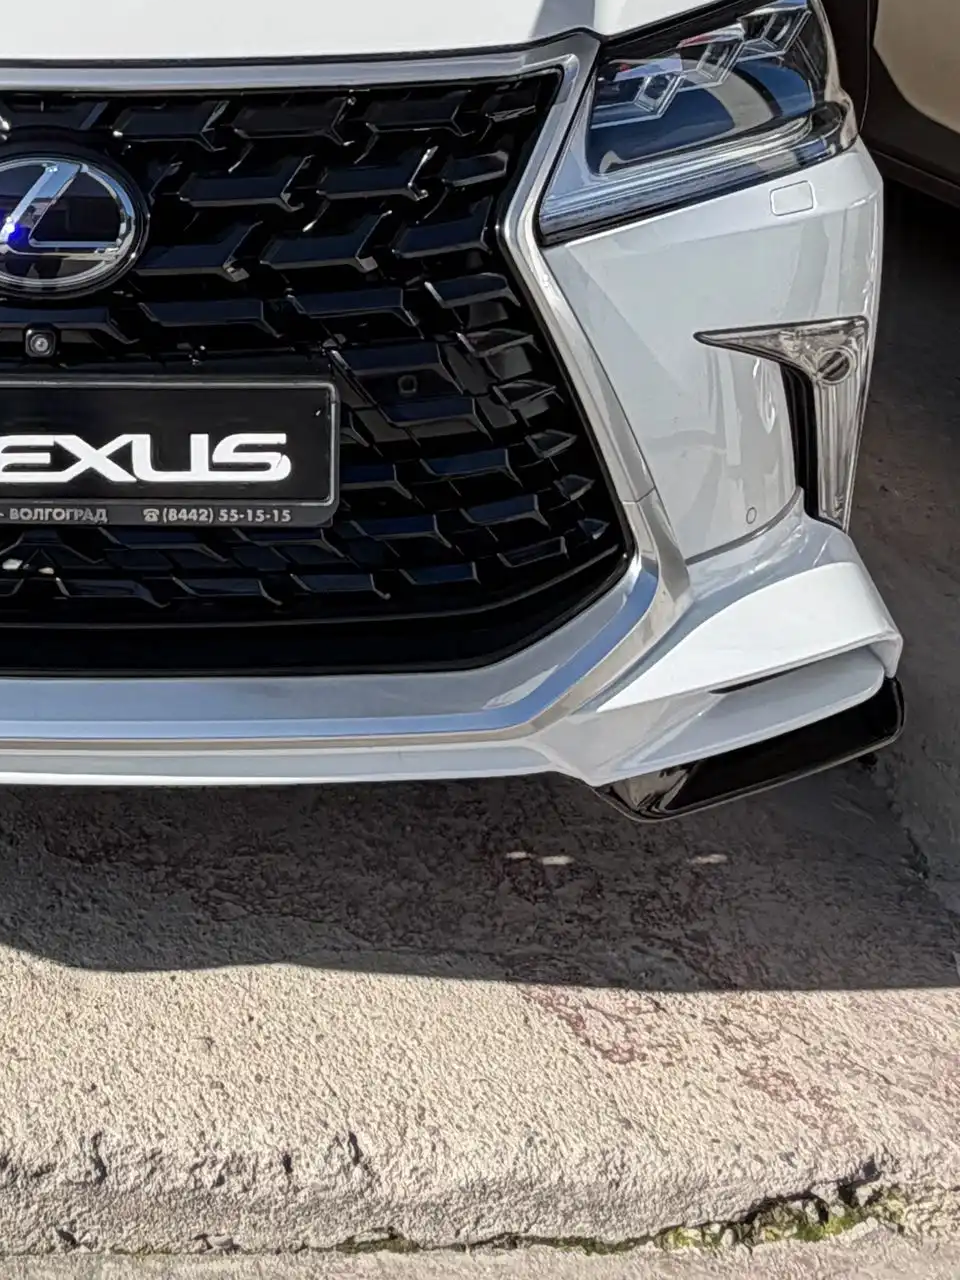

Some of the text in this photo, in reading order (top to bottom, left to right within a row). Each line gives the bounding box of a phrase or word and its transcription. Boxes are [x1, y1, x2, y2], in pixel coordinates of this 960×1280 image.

[9, 507, 108, 523] ВОЛГОГРАД
[162, 507, 291, 523] (8442) 55-15-15
